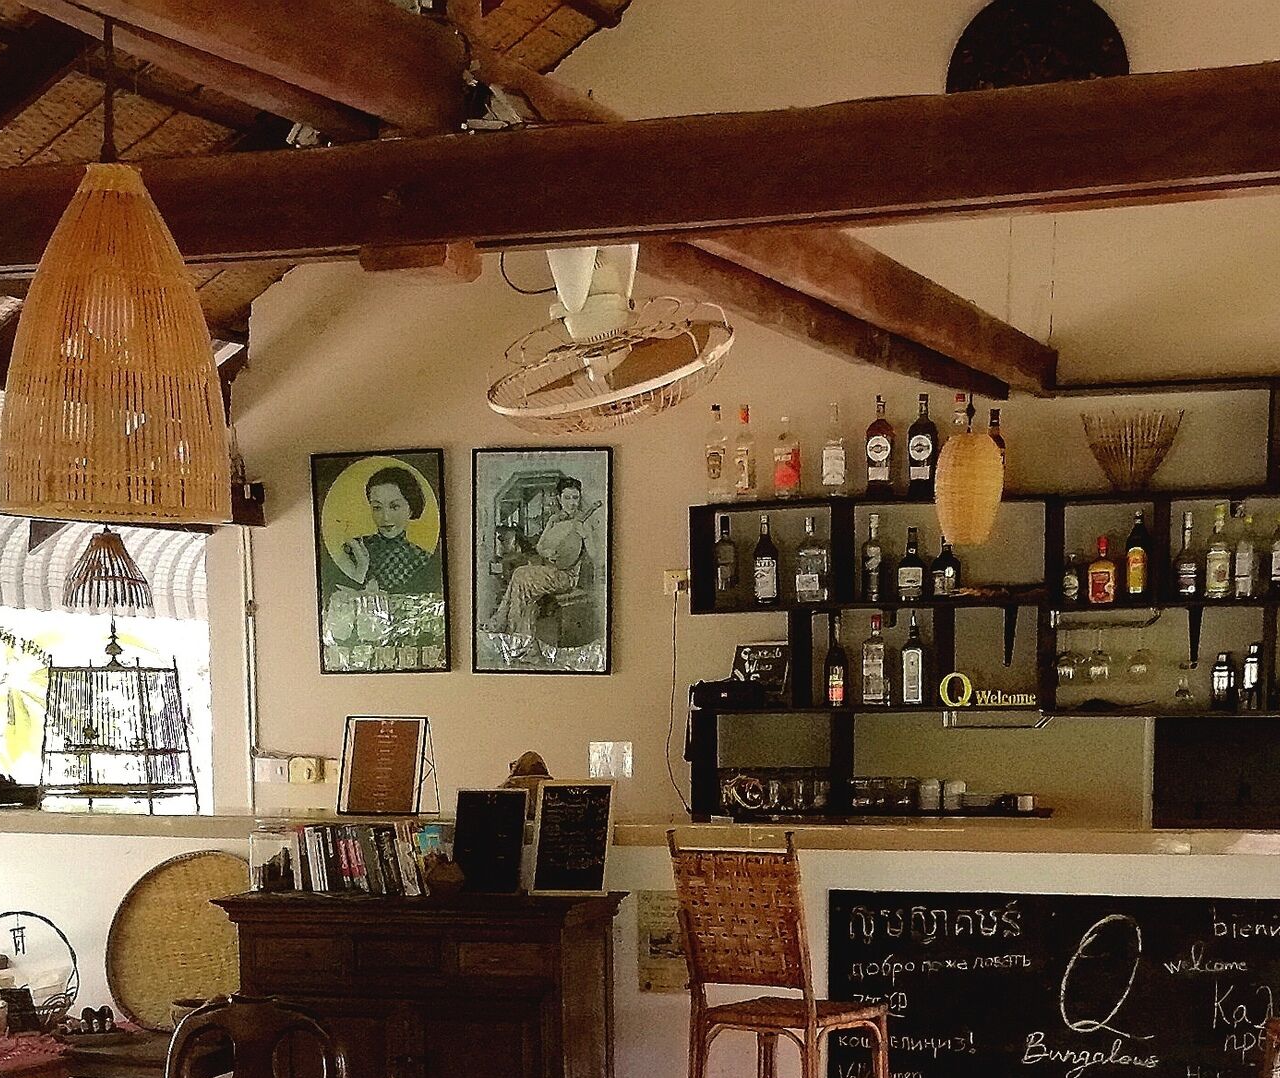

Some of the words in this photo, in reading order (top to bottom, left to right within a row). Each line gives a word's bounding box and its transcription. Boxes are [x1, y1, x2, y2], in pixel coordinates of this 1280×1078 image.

[939, 672, 972, 707] Q
[975, 690, 1037, 706] Welcome
[1163, 943, 1248, 974] welcome
[1060, 913, 1155, 1040] Q
